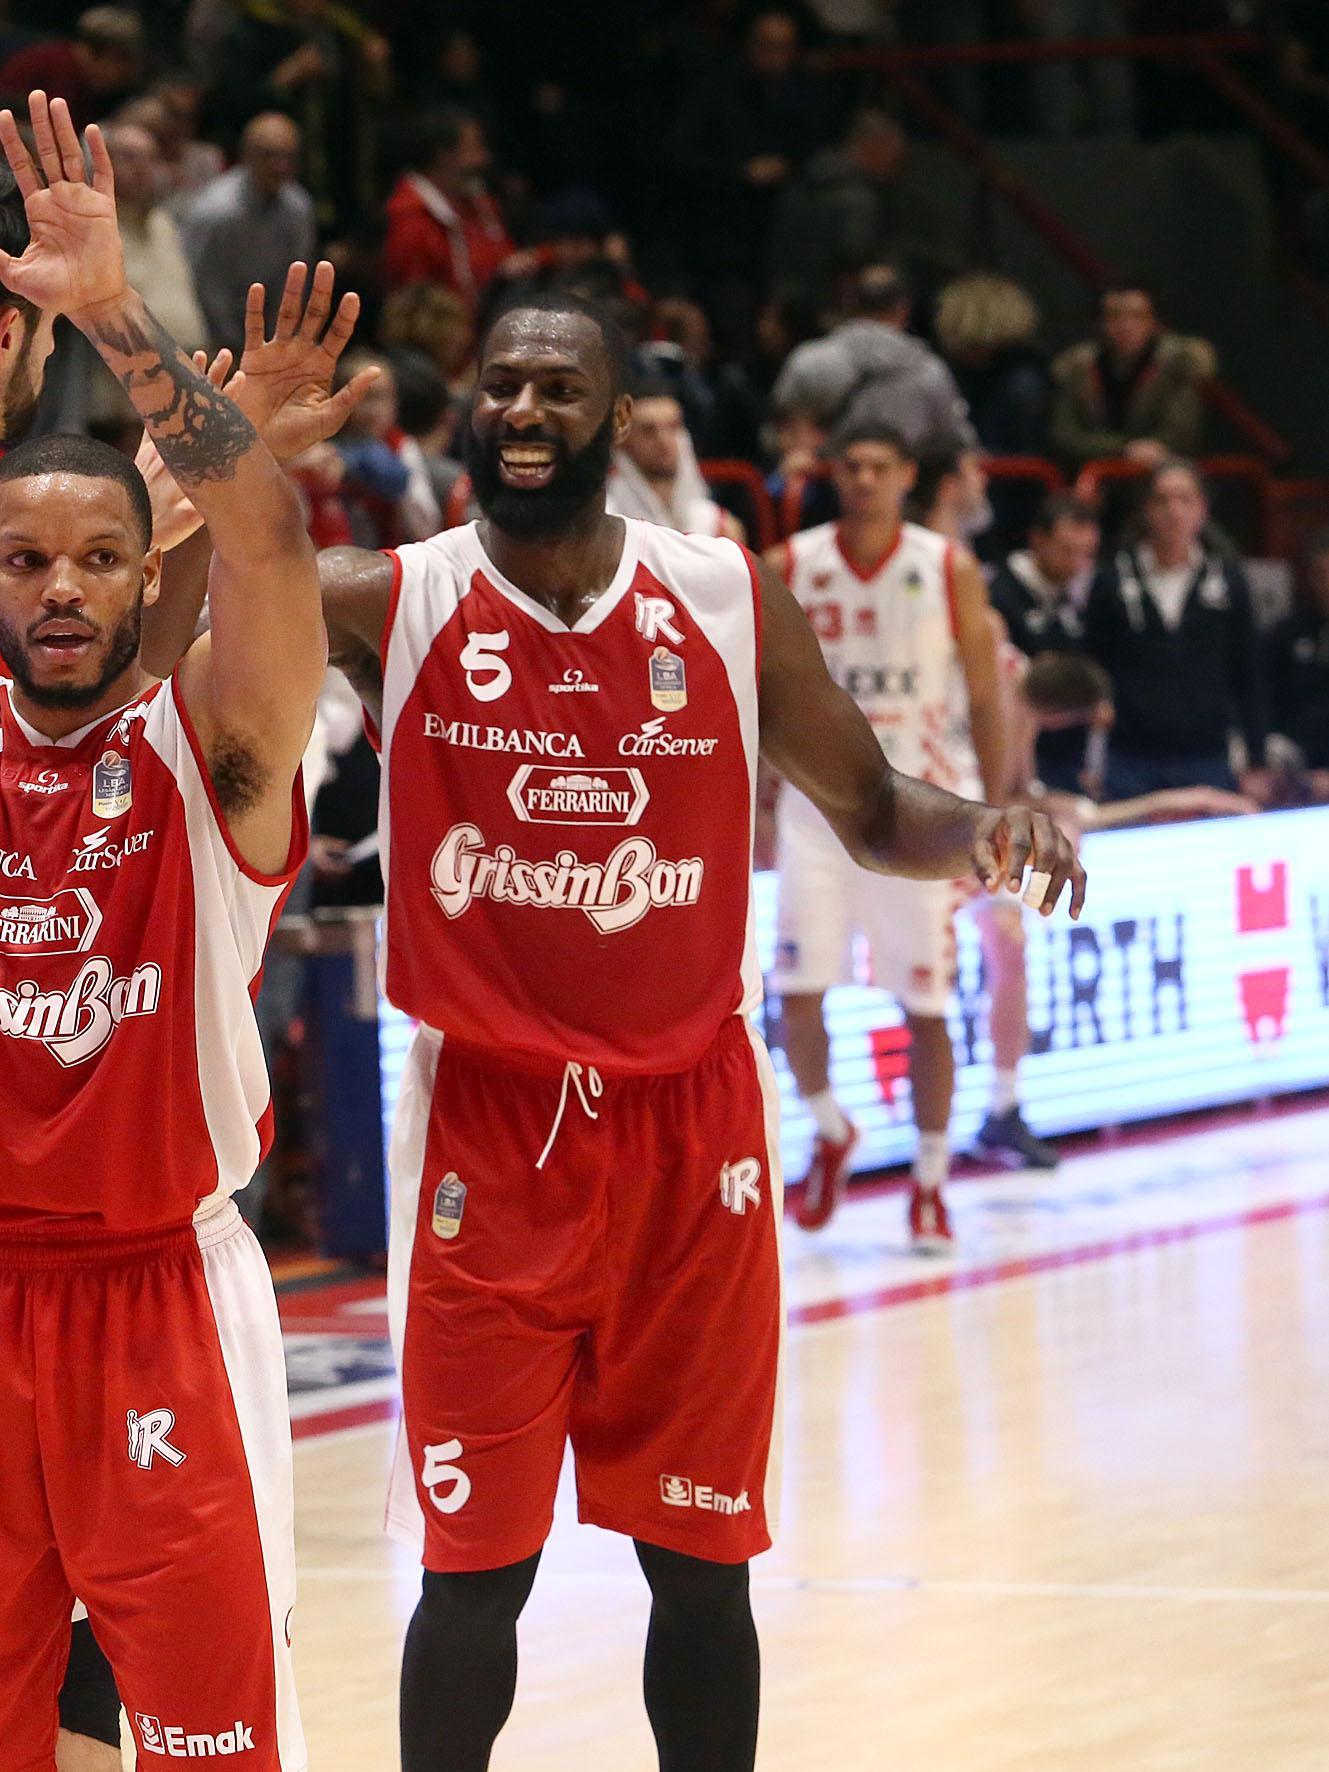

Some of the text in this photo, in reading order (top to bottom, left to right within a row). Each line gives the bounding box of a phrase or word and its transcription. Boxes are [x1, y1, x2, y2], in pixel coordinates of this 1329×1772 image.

[459, 630, 512, 702] 5
[424, 713, 586, 758] EMILBANCA
[618, 732, 719, 756] CarServer
[527, 788, 632, 813] FERRARINI
[430, 822, 704, 935] GrissinBon
[422, 1438, 472, 1514] 5
[163, 1721, 256, 1757] Emak
